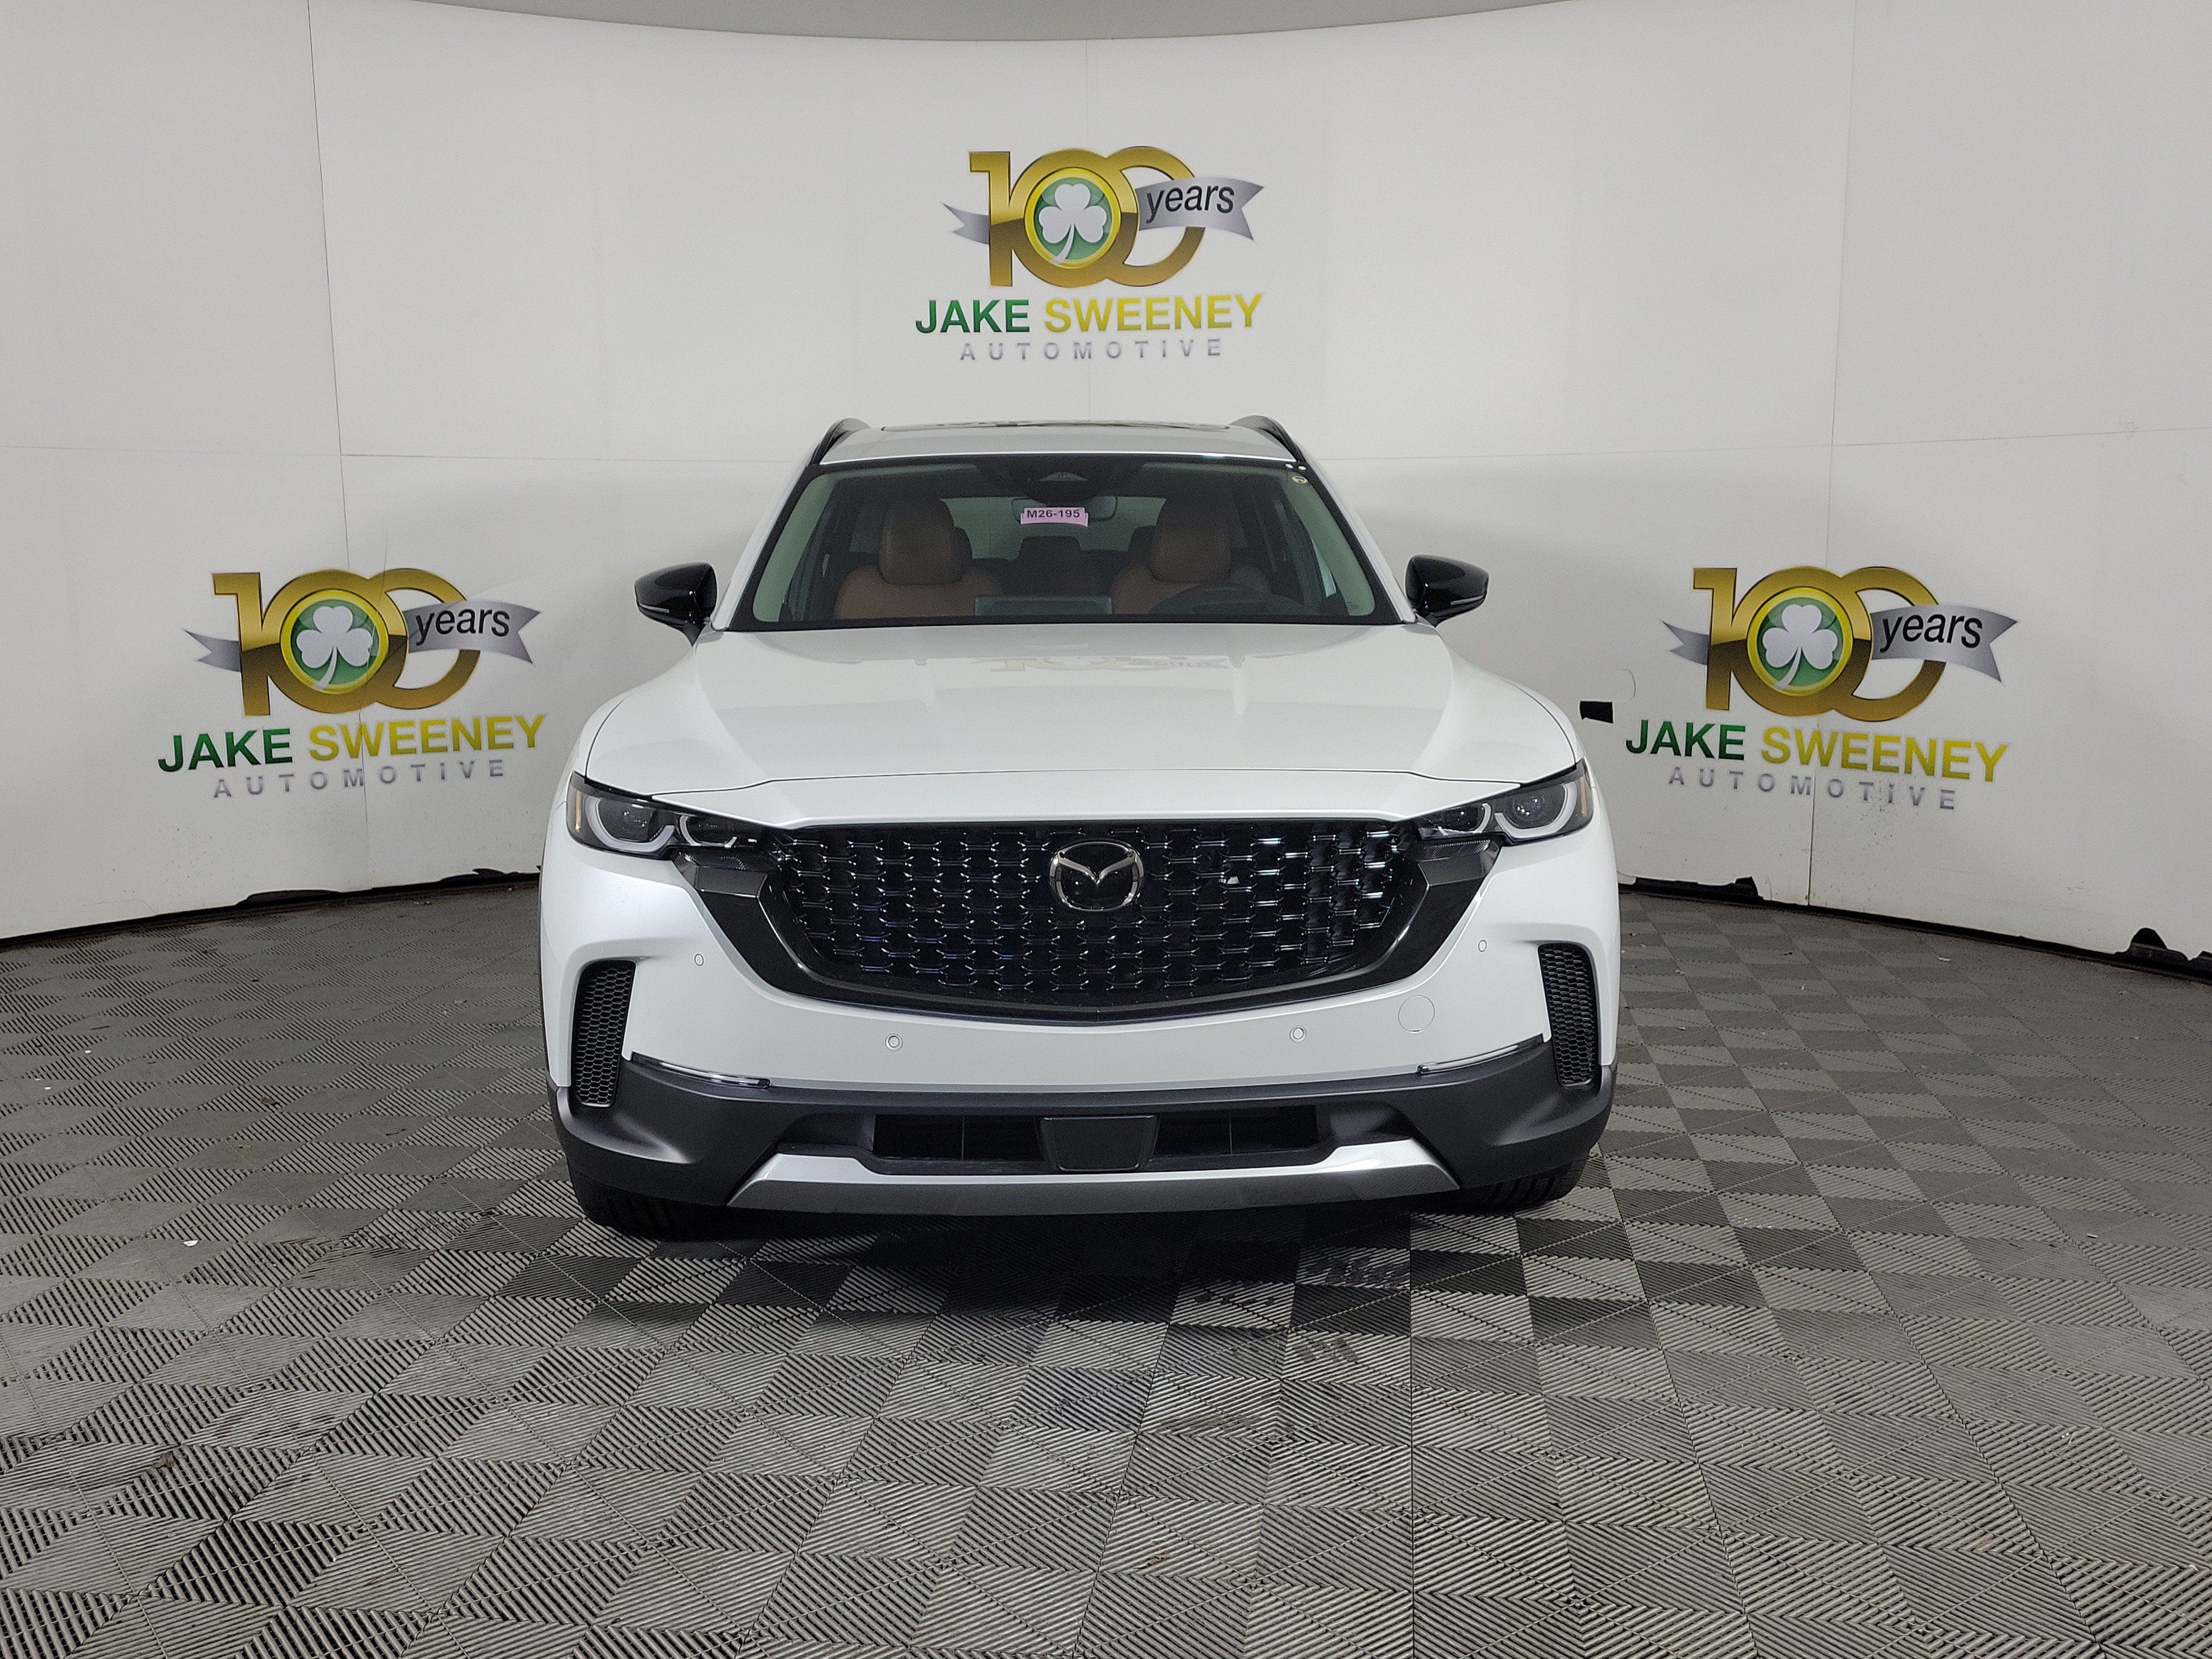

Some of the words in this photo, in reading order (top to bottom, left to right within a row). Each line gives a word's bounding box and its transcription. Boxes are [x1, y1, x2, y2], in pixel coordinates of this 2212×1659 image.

[969, 146, 1206, 287] 100
[1146, 182, 1235, 223] years
[915, 299, 1030, 333] JAKE
[1045, 293, 1263, 332] SWEENEY
[960, 338, 1221, 360] AUTOMOTIVE
[1027, 510, 1080, 518] M26-195
[212, 568, 481, 716] 100
[415, 608, 510, 646] years
[1692, 566, 1946, 722] 100
[1880, 614, 1983, 653] years
[158, 728, 293, 772] JAKE
[309, 714, 546, 760] SWEENEY
[1626, 719, 1746, 760] JAKE
[1760, 726, 2008, 782] SWEENEY
[213, 759, 503, 798] AUTOMOTIVE
[1668, 767, 1955, 810] AUTOMOTIVE
